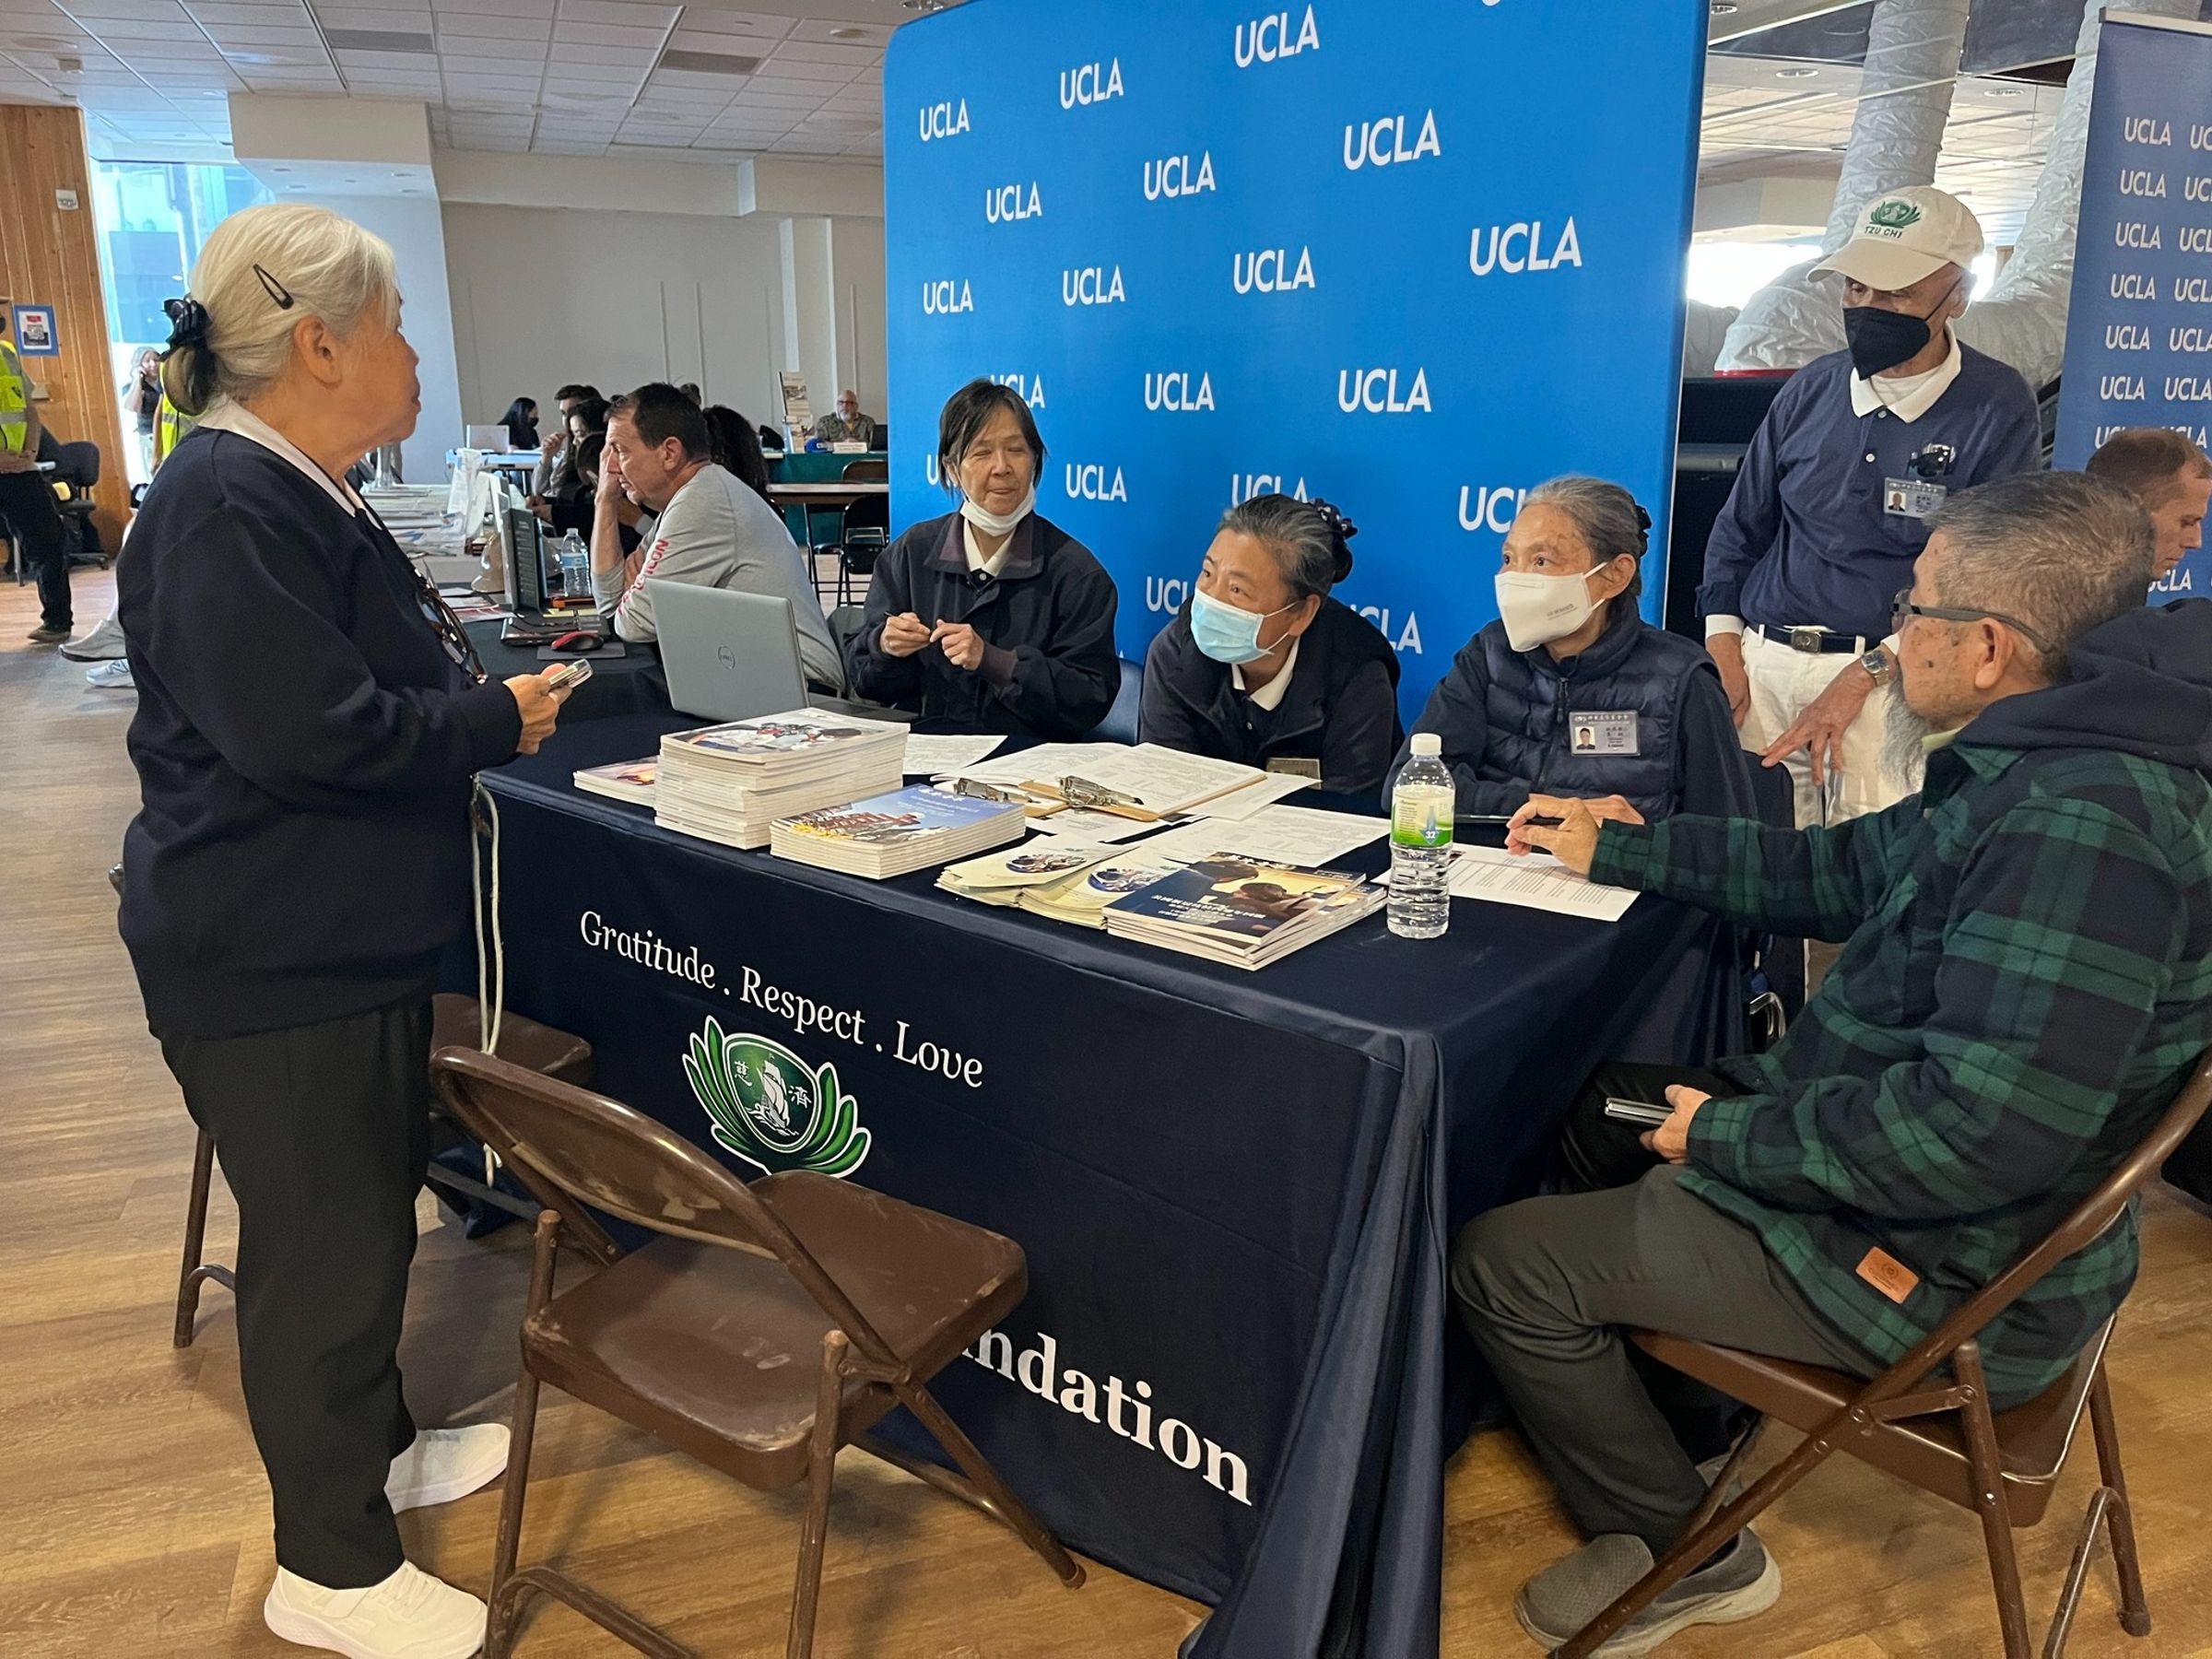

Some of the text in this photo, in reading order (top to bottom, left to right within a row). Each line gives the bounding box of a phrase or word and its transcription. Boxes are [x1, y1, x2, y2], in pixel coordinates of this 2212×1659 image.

[1235, 4, 1319, 67] UCLA
[1060, 57, 1124, 109] UCLA
[920, 98, 970, 141] UCLA
[1344, 109, 1440, 170] UCLA
[2124, 117, 2171, 146] UCLA
[1144, 150, 1216, 200] UCLA
[2120, 170, 2166, 197] UCLA
[986, 182, 1041, 223] UCLA
[1470, 217, 1582, 276] UCLA
[1865, 226, 1902, 239] TZU CHI
[2115, 222, 2160, 249] UCLA
[1064, 265, 1124, 305] UCLA
[1234, 246, 1315, 293] UCLA
[2111, 274, 2212, 302] UCLA UCL
[924, 280, 973, 313] UCLA
[2105, 325, 2149, 349] UCLA
[1145, 371, 1214, 411] UCLA
[1338, 368, 1431, 412] UCLA
[2100, 376, 2212, 401] UCLA UCLA
[1066, 464, 1126, 501] UCLA
[1459, 486, 1526, 533] UC
[1147, 576, 1188, 615] UC
[1349, 604, 1423, 654] LA
[1425, 830, 1436, 839] 32
[580, 911, 715, 989] Gratitude
[740, 966, 865, 1044] Respect
[893, 1020, 983, 1088] Love
[962, 1329, 1252, 1506] ndation
